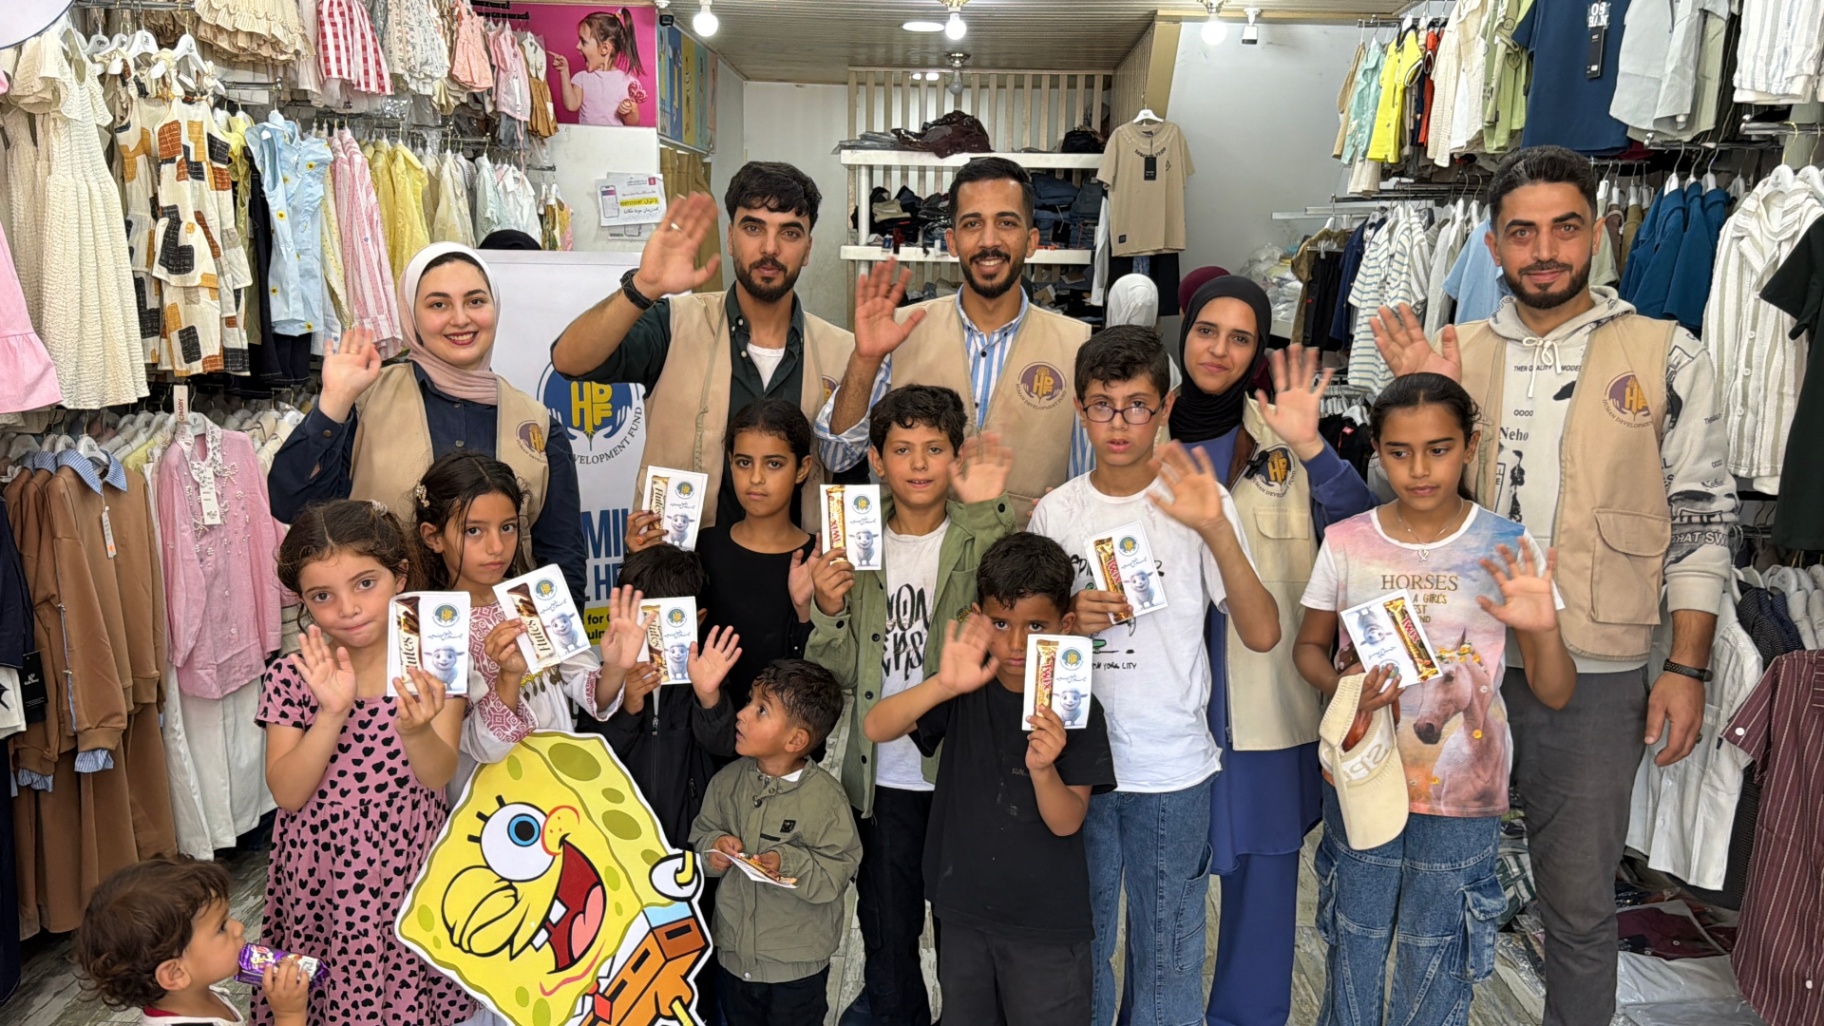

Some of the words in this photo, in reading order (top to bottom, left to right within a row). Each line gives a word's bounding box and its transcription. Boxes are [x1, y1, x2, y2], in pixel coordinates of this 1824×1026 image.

[571, 380, 613, 430] HDF
[573, 436, 631, 466] VELOPMENT
[627, 406, 643, 439] FUND
[1106, 558, 1121, 584] TWIX
[1380, 574, 1459, 592] HORSES
[1422, 593, 1447, 605] GIRL'S
[587, 614, 604, 625] for
[1401, 615, 1419, 644] TWIX
[1042, 663, 1053, 691] TWIX
[1121, 662, 1138, 670] CITY
